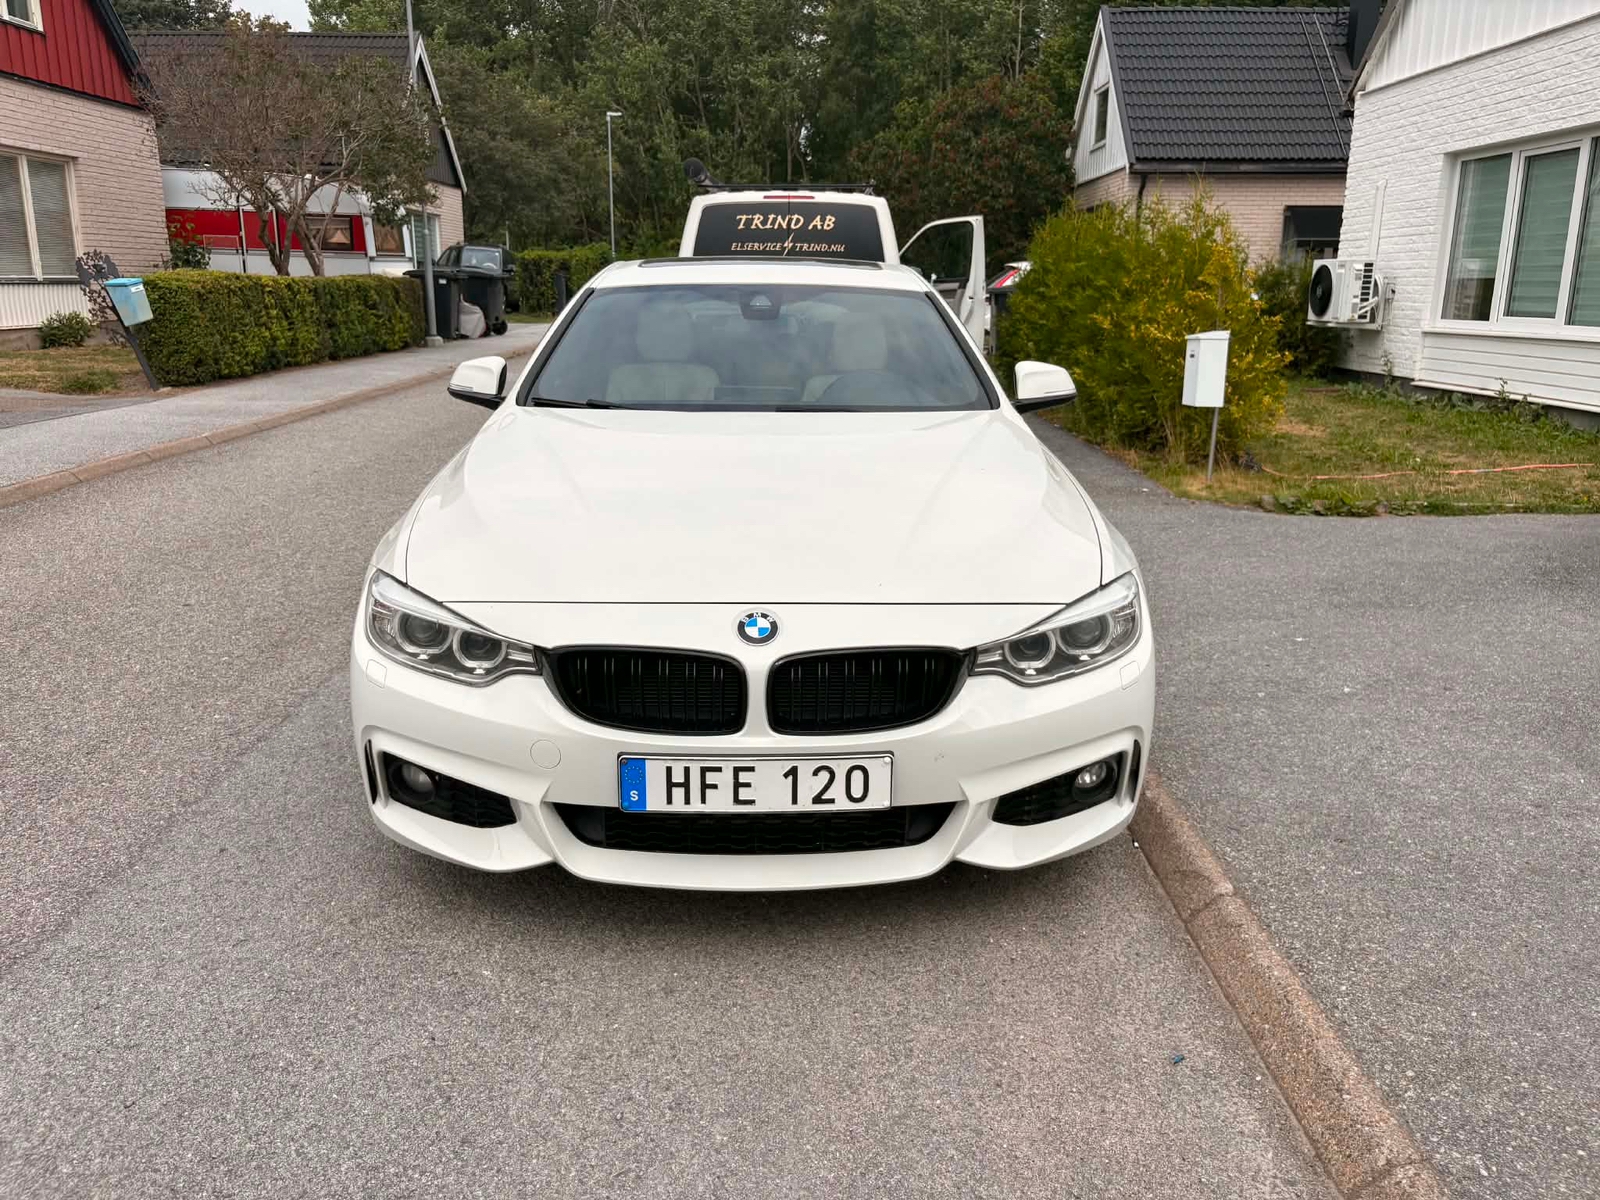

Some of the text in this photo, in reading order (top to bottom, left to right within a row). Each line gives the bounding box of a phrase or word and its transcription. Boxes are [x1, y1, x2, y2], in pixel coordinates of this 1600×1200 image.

[736, 214, 836, 231] TRIND AB
[731, 242, 846, 252] ELSERVICE TRIND.NU
[742, 612, 775, 623] BMW
[665, 764, 870, 806] HFE 120
[629, 790, 639, 801] S
